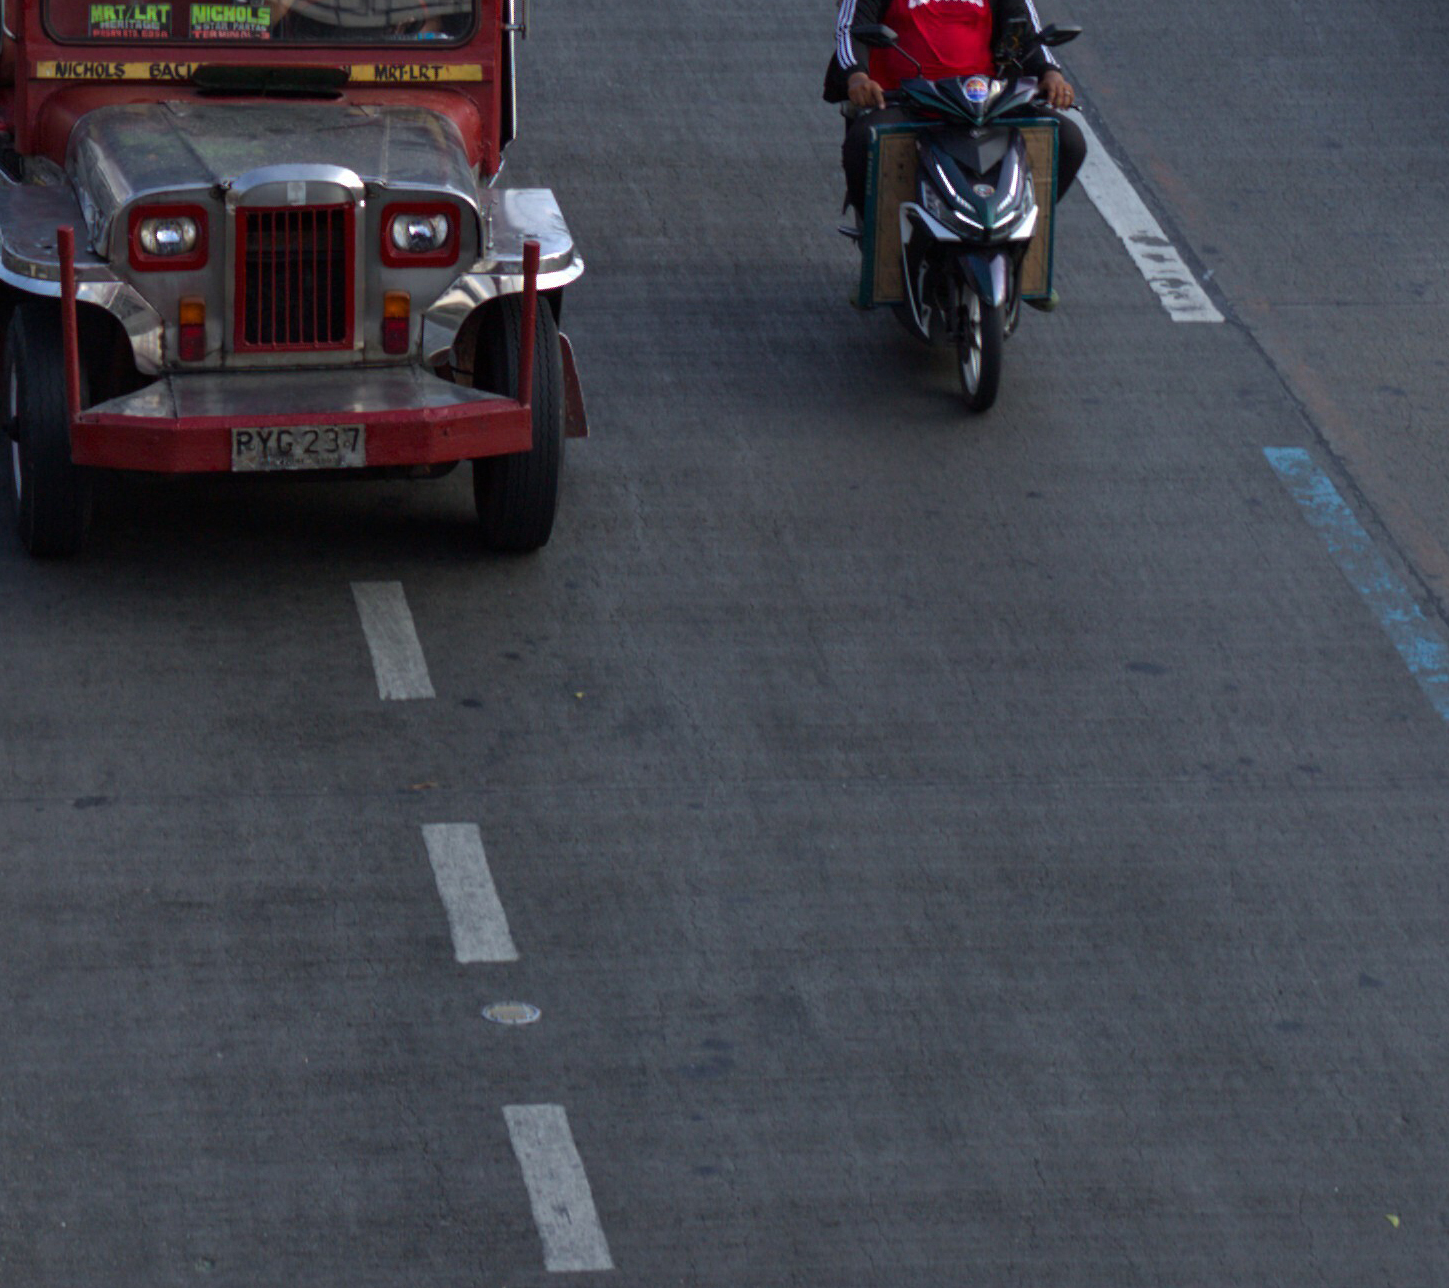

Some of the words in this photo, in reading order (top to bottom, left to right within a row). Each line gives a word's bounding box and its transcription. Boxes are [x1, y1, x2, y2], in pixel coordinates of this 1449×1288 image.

[191, 4, 271, 25] NICHOLS
[55, 61, 126, 79] NICHOLS
[303, 427, 361, 454] 237
